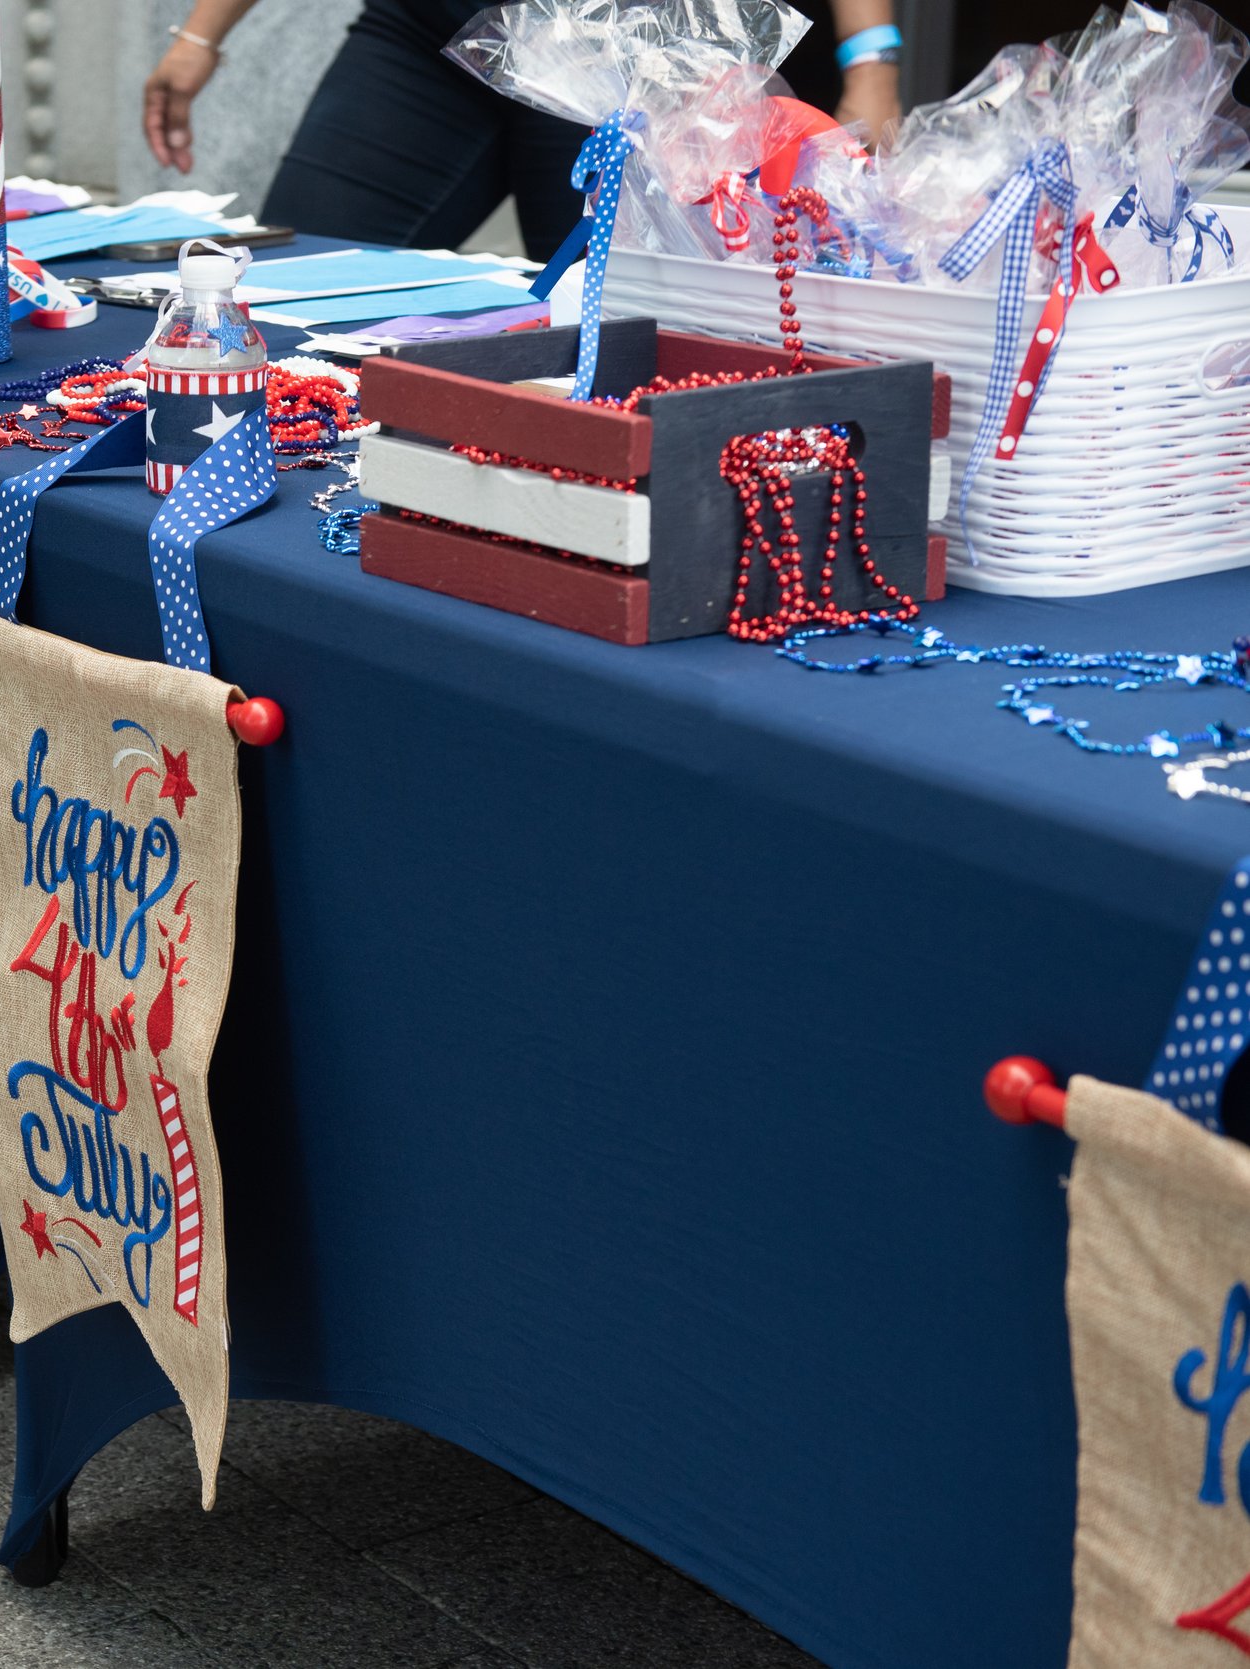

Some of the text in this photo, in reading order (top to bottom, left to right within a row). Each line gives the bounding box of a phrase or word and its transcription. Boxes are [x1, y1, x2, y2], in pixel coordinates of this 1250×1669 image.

[8, 271, 32, 294] US
[11, 727, 180, 980] happy
[10, 894, 128, 1113] 4th
[8, 1060, 172, 1308] July
